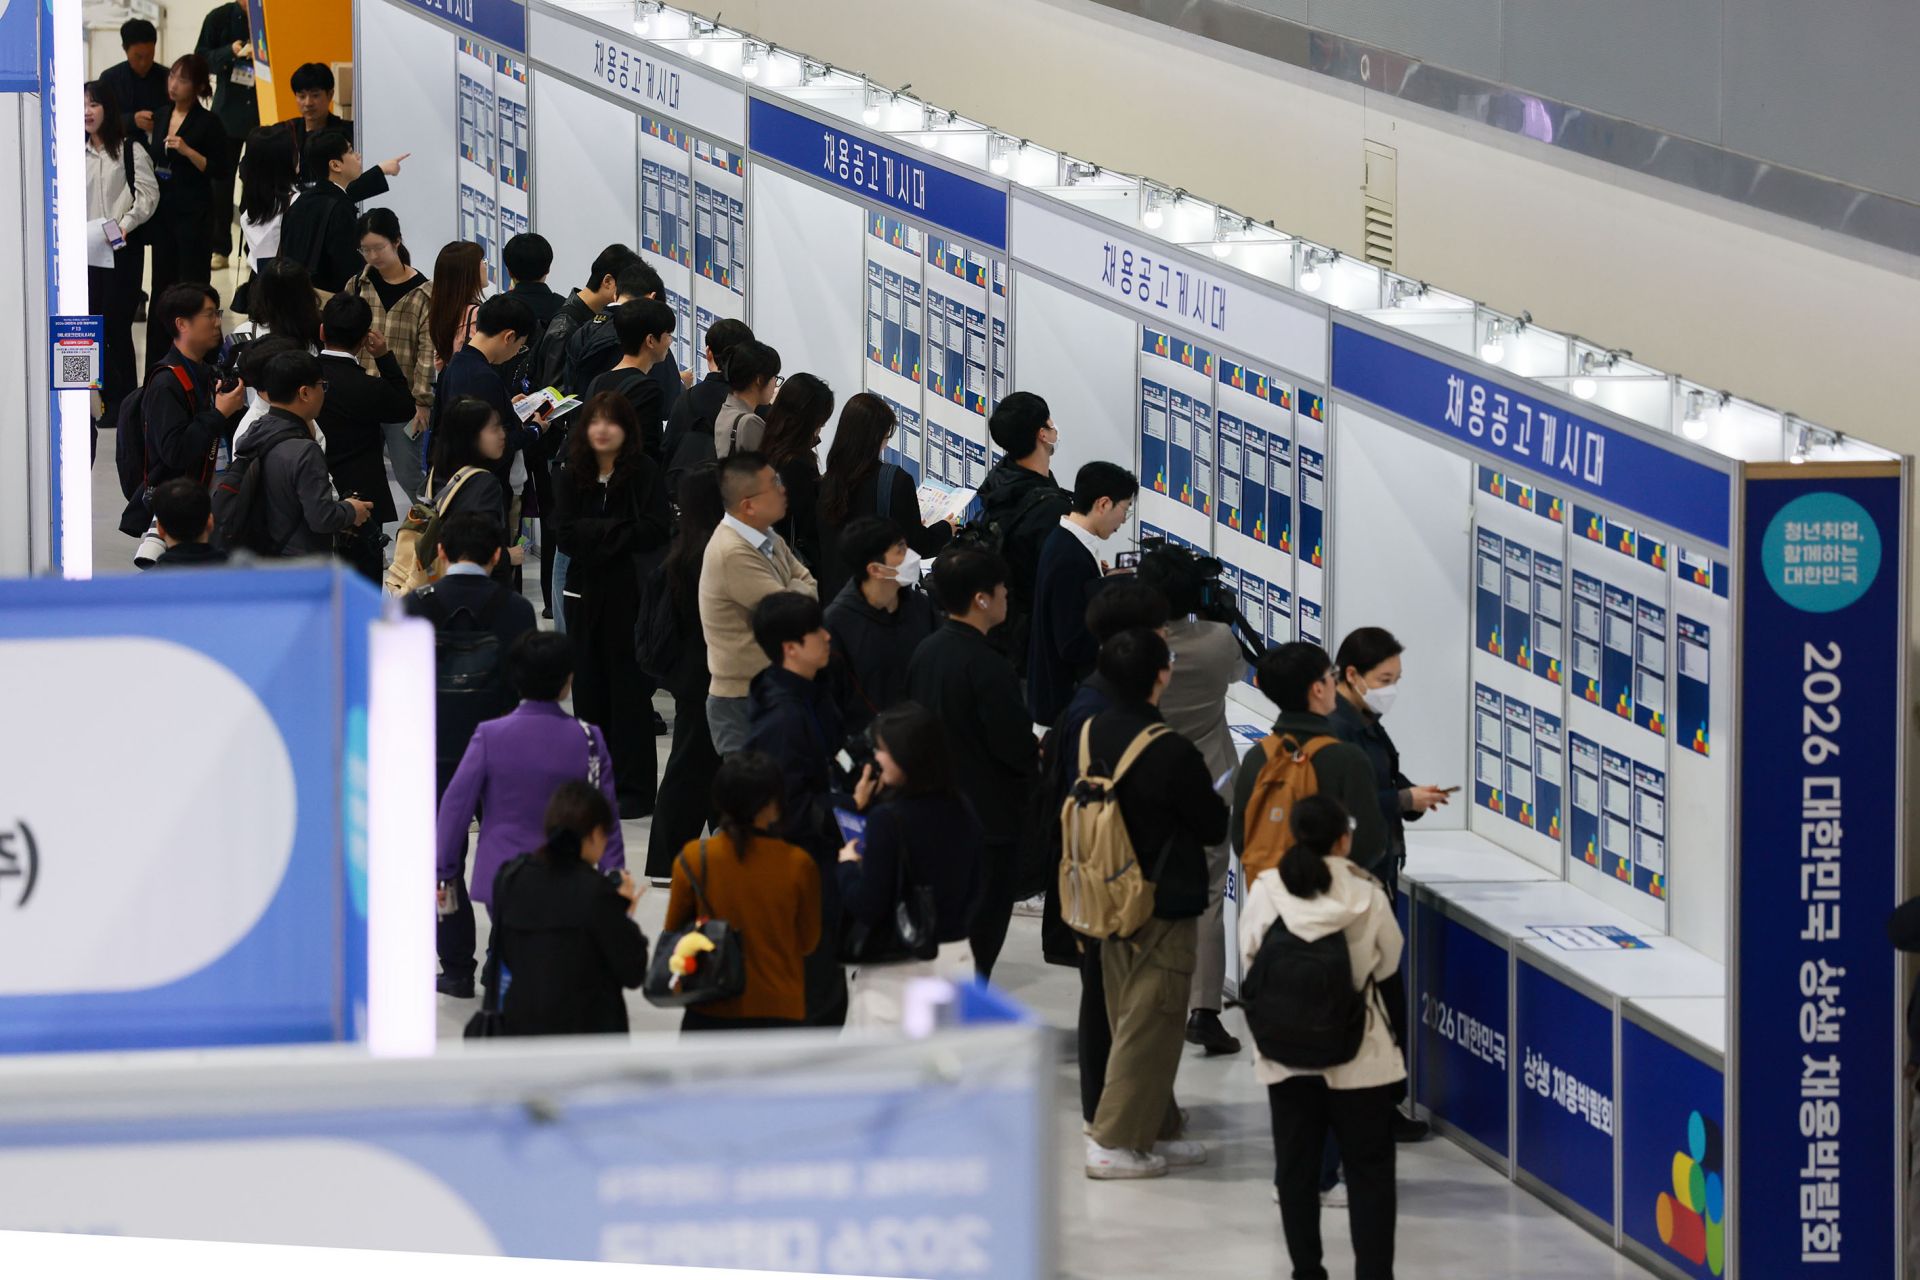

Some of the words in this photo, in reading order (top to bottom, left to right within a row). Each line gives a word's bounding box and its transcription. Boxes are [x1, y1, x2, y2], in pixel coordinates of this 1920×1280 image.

[594, 39, 681, 111] 채용공고게시대
[823, 131, 926, 211] 채용공고게시대
[1101, 240, 1226, 332] 채용공고게시대
[1445, 374, 1606, 488] 채용공고게시대
[1783, 544, 1858, 563] 함께하는
[1783, 565, 1858, 585] 대한민국
[1784, 520, 1865, 544] 청년취업,
[1802, 640, 1843, 766] 2026
[1800, 776, 1844, 943] 대한민국
[1421, 991, 1455, 1041] 2026
[1457, 1010, 1507, 1071] 대한민국
[1799, 957, 1847, 1044] 상생
[1523, 1046, 1550, 1097] 상생
[1552, 1065, 1613, 1137] 채용박람회
[1798, 1054, 1842, 1263] 채용박람회
